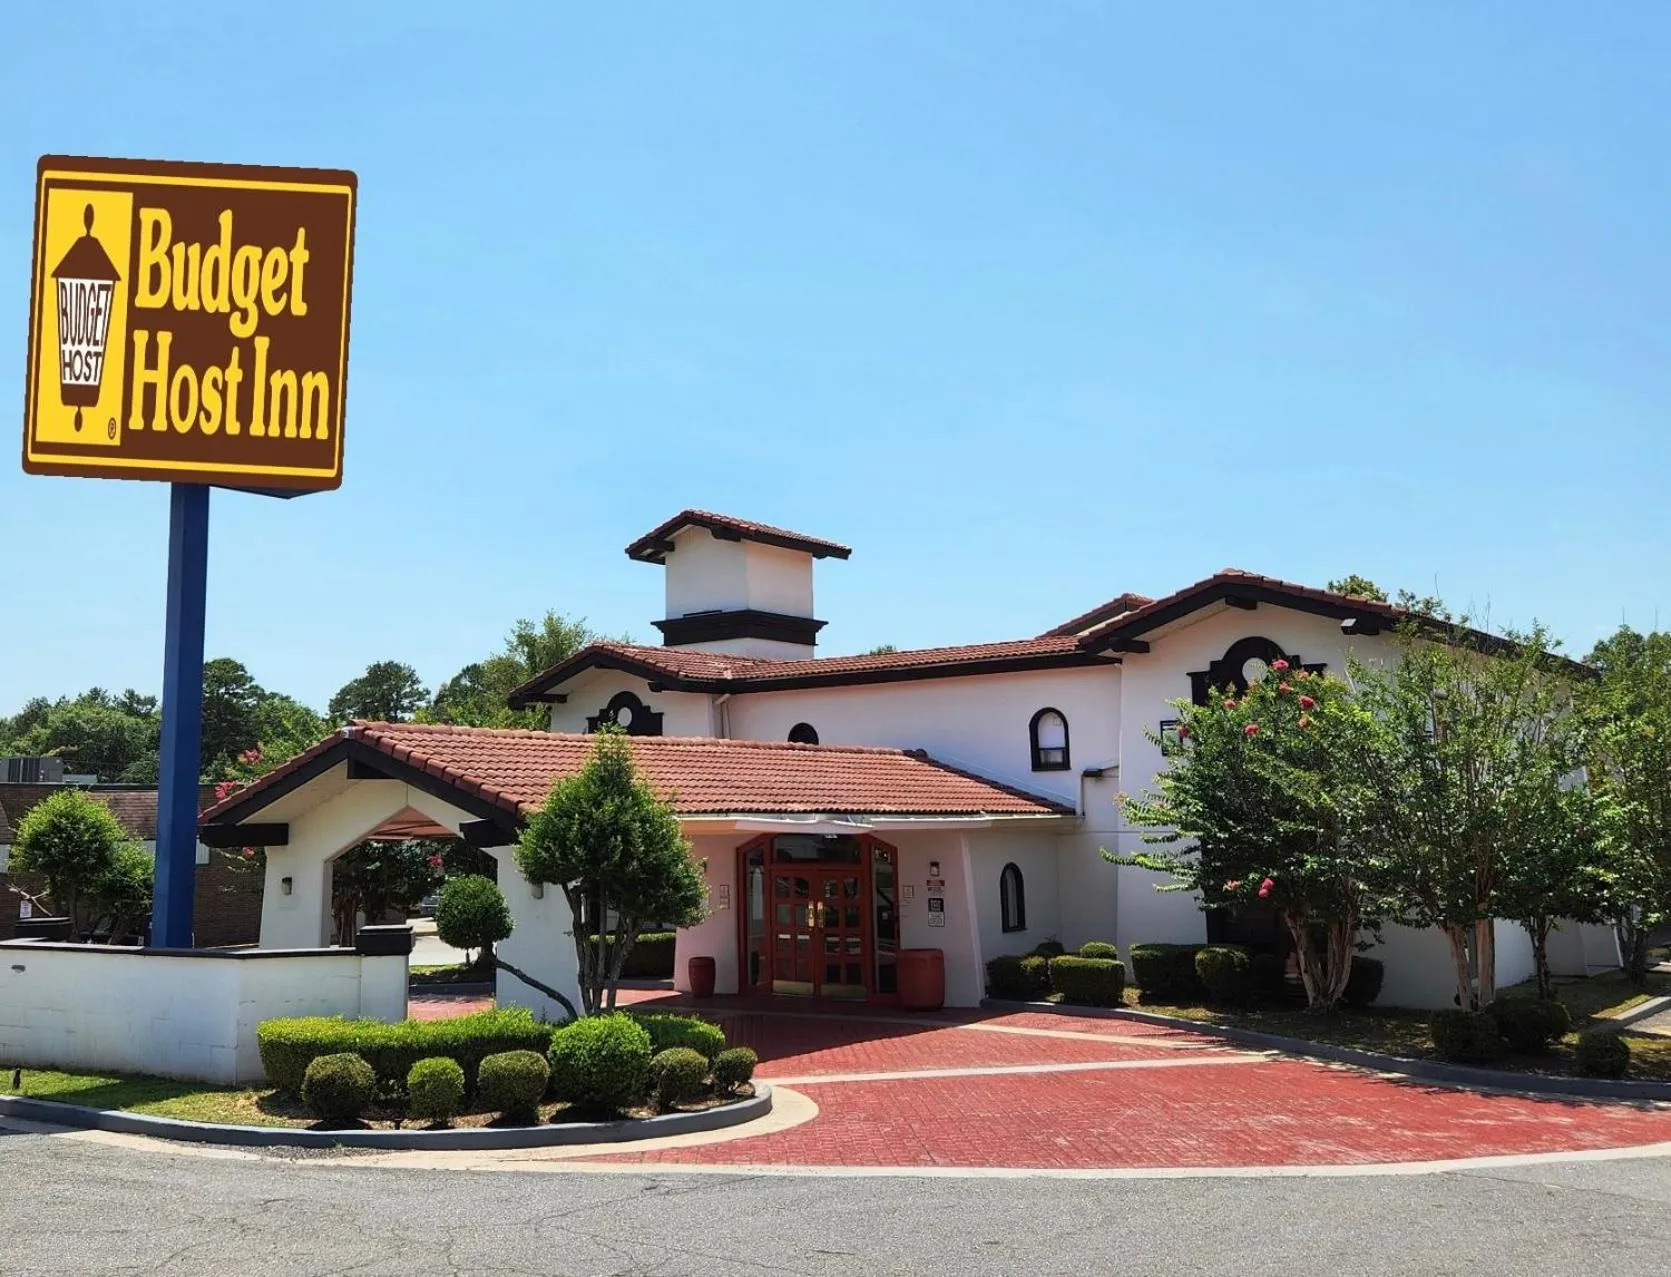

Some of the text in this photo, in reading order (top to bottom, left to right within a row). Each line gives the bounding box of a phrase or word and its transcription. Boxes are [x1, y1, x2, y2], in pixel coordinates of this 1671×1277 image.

[60, 281, 113, 347] BUDGET
[134, 207, 310, 338] Budget
[62, 349, 103, 382] HOST
[128, 329, 330, 440] Host Inn
